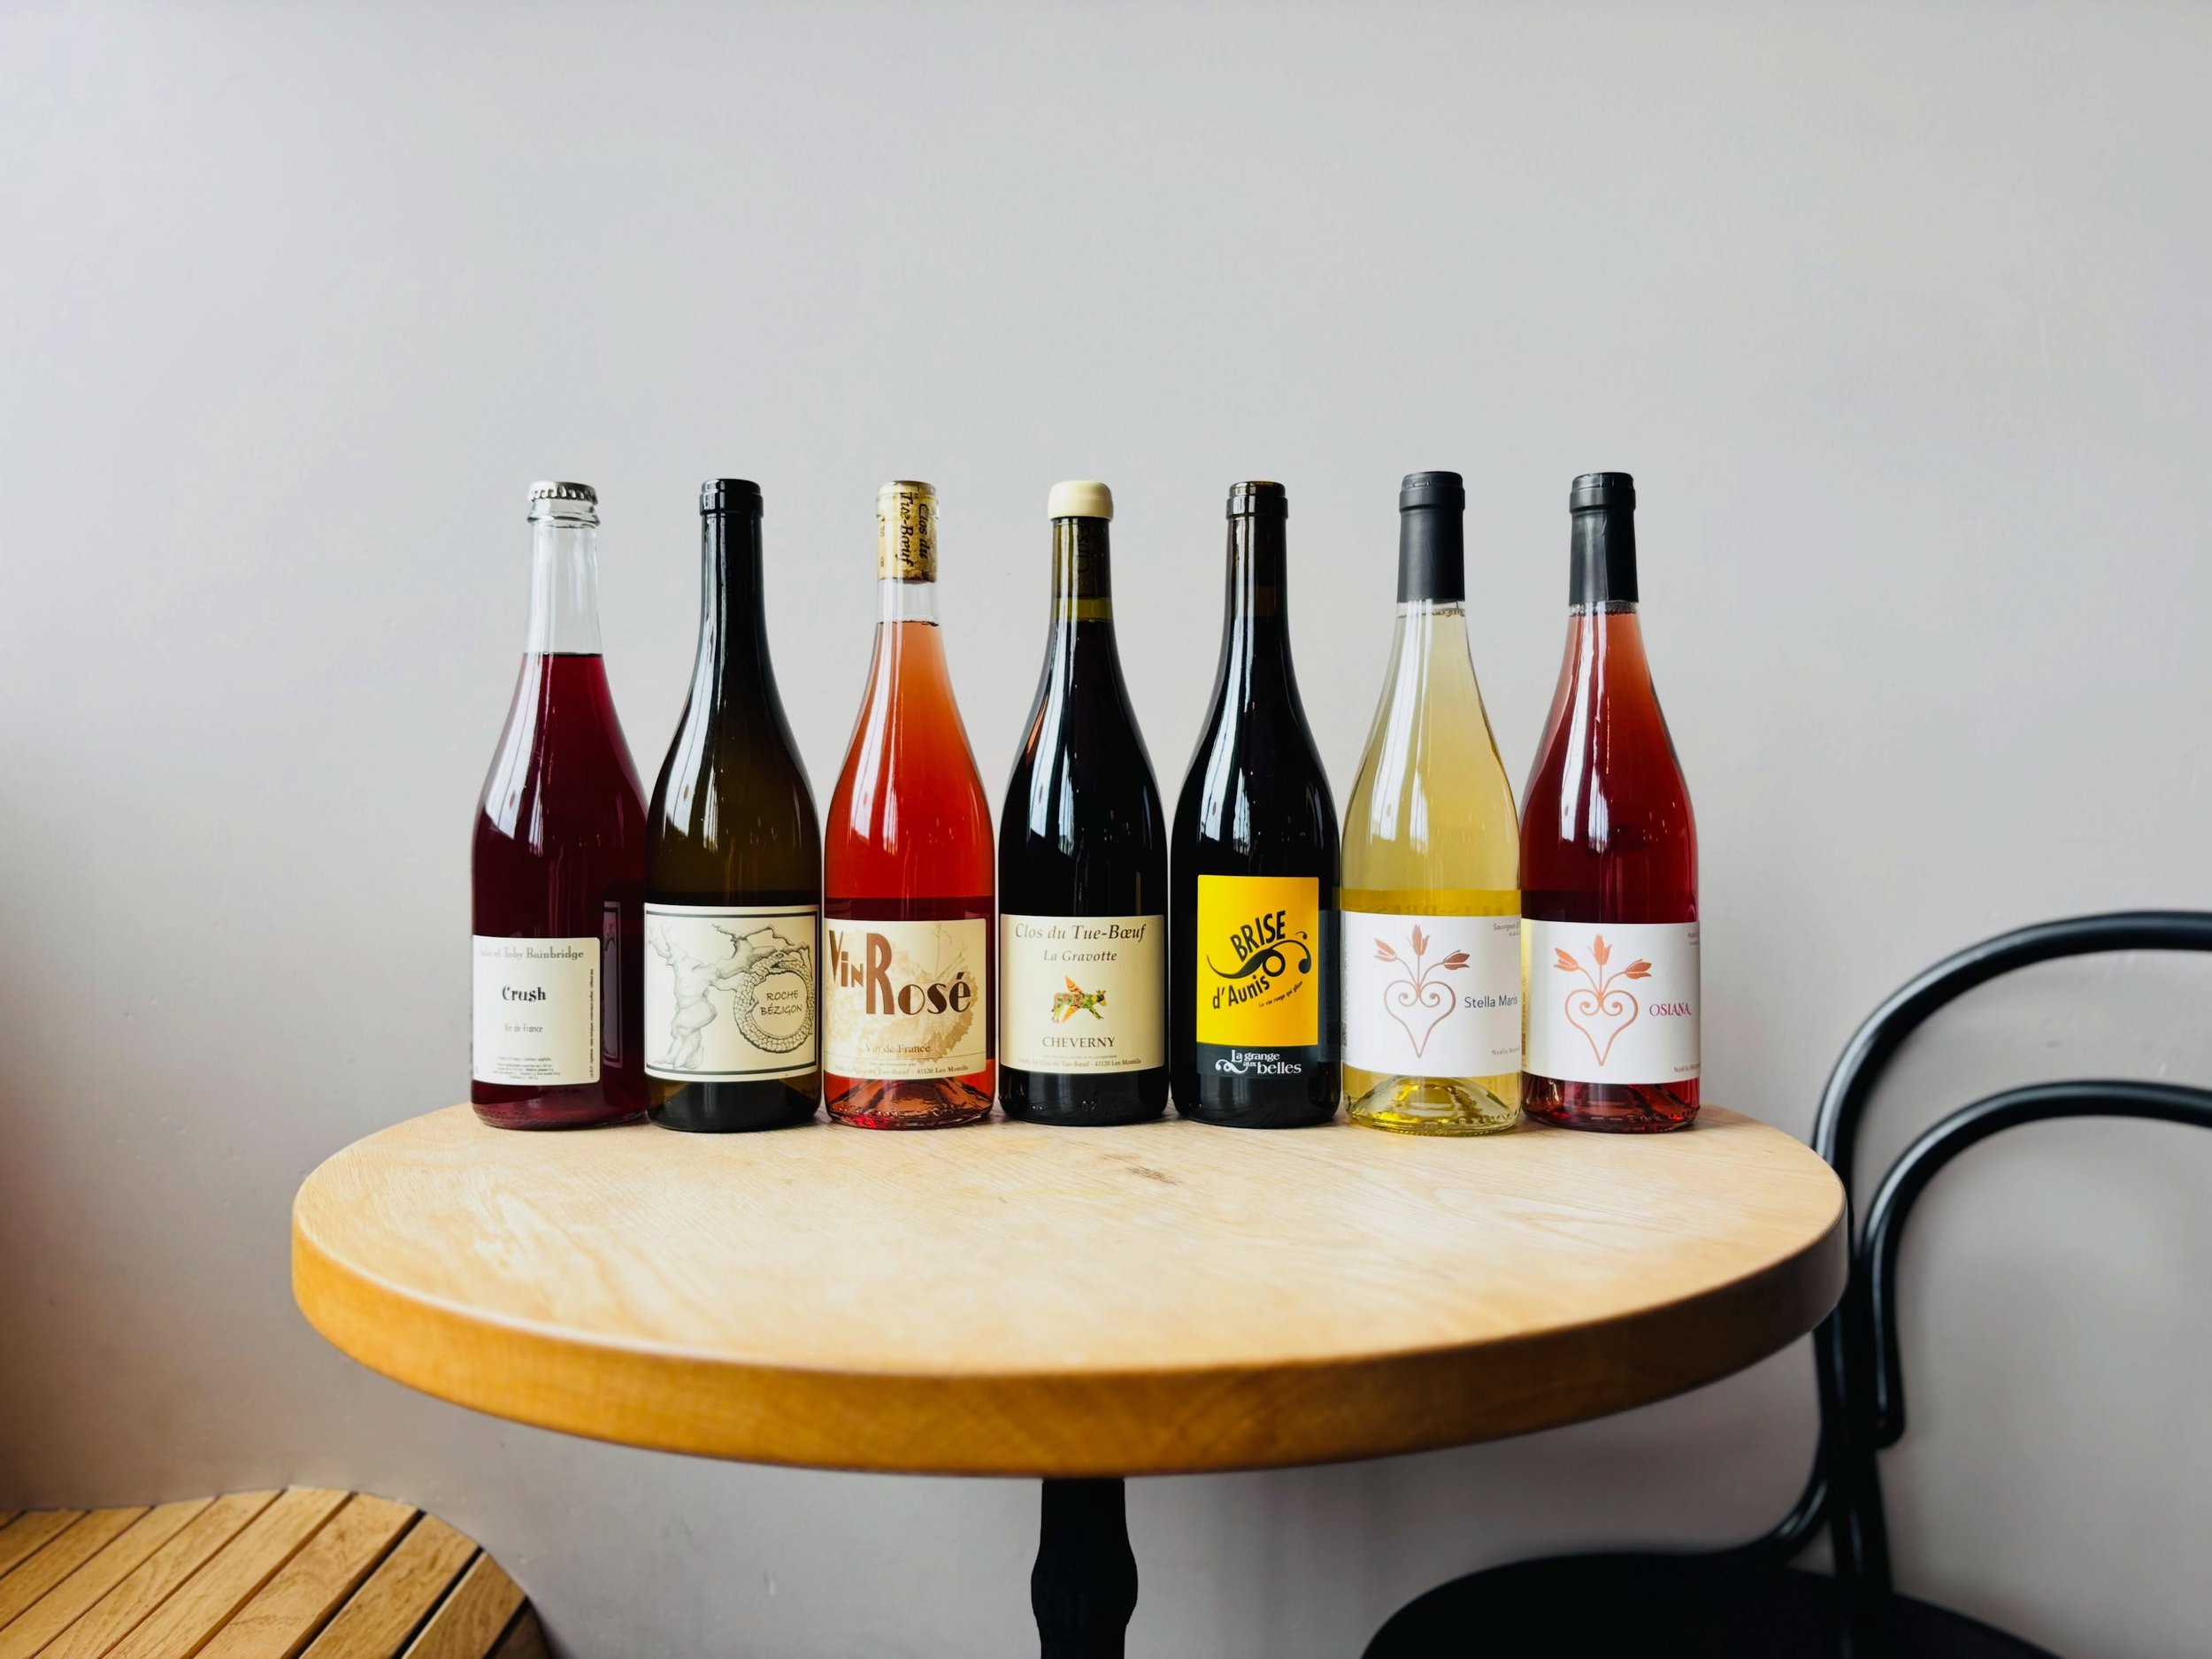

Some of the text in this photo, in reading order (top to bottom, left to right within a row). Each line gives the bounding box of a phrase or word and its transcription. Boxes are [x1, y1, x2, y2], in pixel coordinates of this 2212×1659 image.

[918, 503, 930, 559] Clos du
[1015, 922, 1147, 943] Clos du Tue-Bœuf
[1230, 910, 1286, 963] BRISE
[503, 946, 523, 960] Toby
[526, 945, 585, 961] Bainbridge
[1043, 949, 1118, 962] La Gravotte
[502, 985, 547, 1002] Crush
[766, 989, 799, 1001] ROCHE
[1212, 974, 1271, 1010] d'Aunis
[1464, 993, 1518, 1009] Stella Maris
[760, 1002, 803, 1016] BÉZIGON
[1648, 1002, 1692, 1017] OSIANA
[503, 1023, 543, 1033] Vin de France
[864, 1043, 931, 1054] Vin de France
[1042, 1036, 1117, 1048] CHEVERNY
[1230, 1049, 1280, 1063] La grange
[1256, 1062, 1302, 1074] belles
